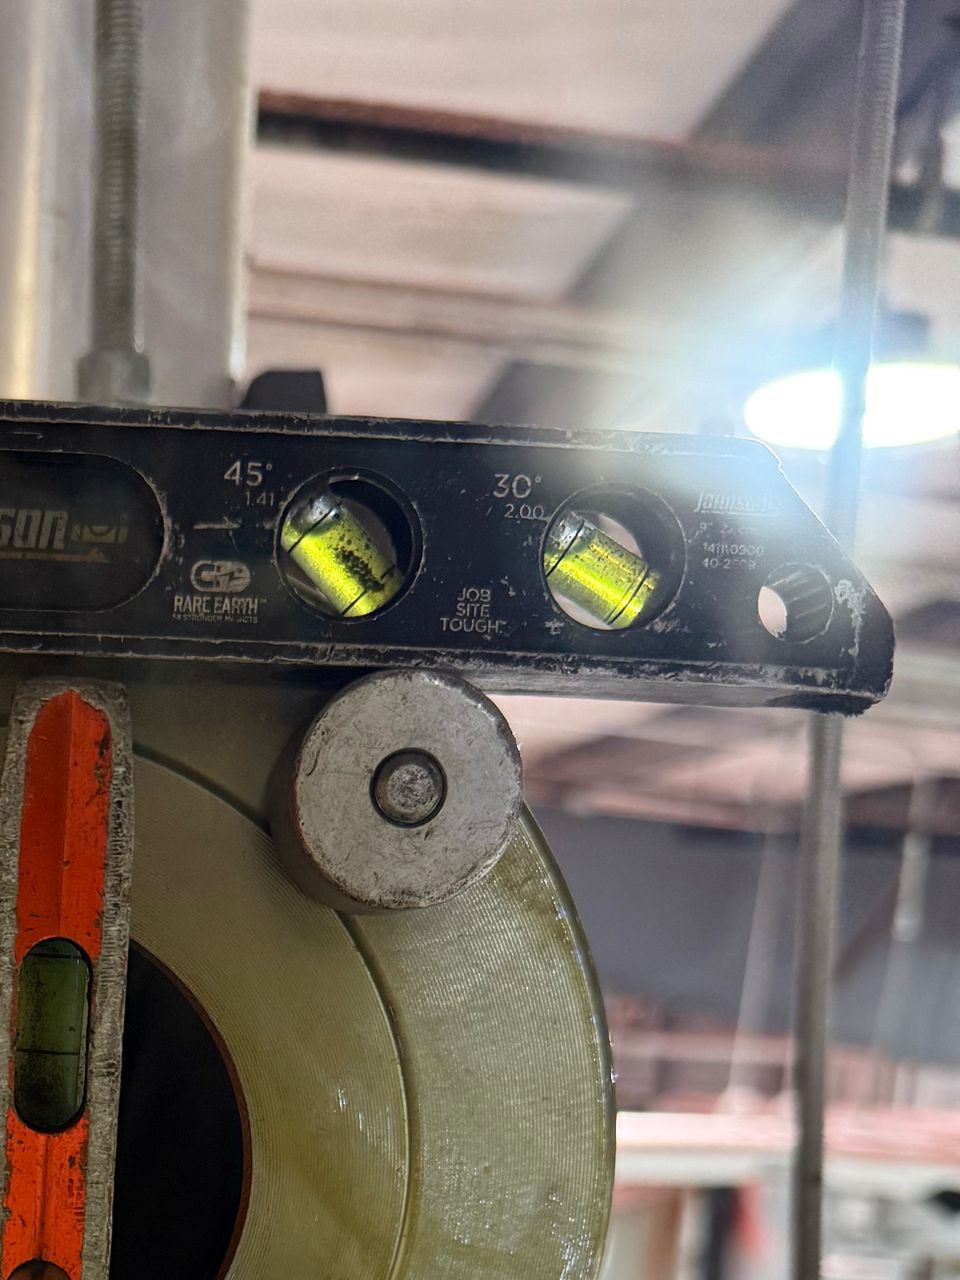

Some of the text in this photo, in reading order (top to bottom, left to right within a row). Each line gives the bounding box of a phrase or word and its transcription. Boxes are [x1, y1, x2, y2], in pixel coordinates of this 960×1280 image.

[245, 491, 275, 507] 1.41
[503, 503, 545, 519] 2.00
[457, 587, 491, 602] JOB
[173, 594, 258, 615] RARE EARTH
[456, 603, 491, 617] SITE
